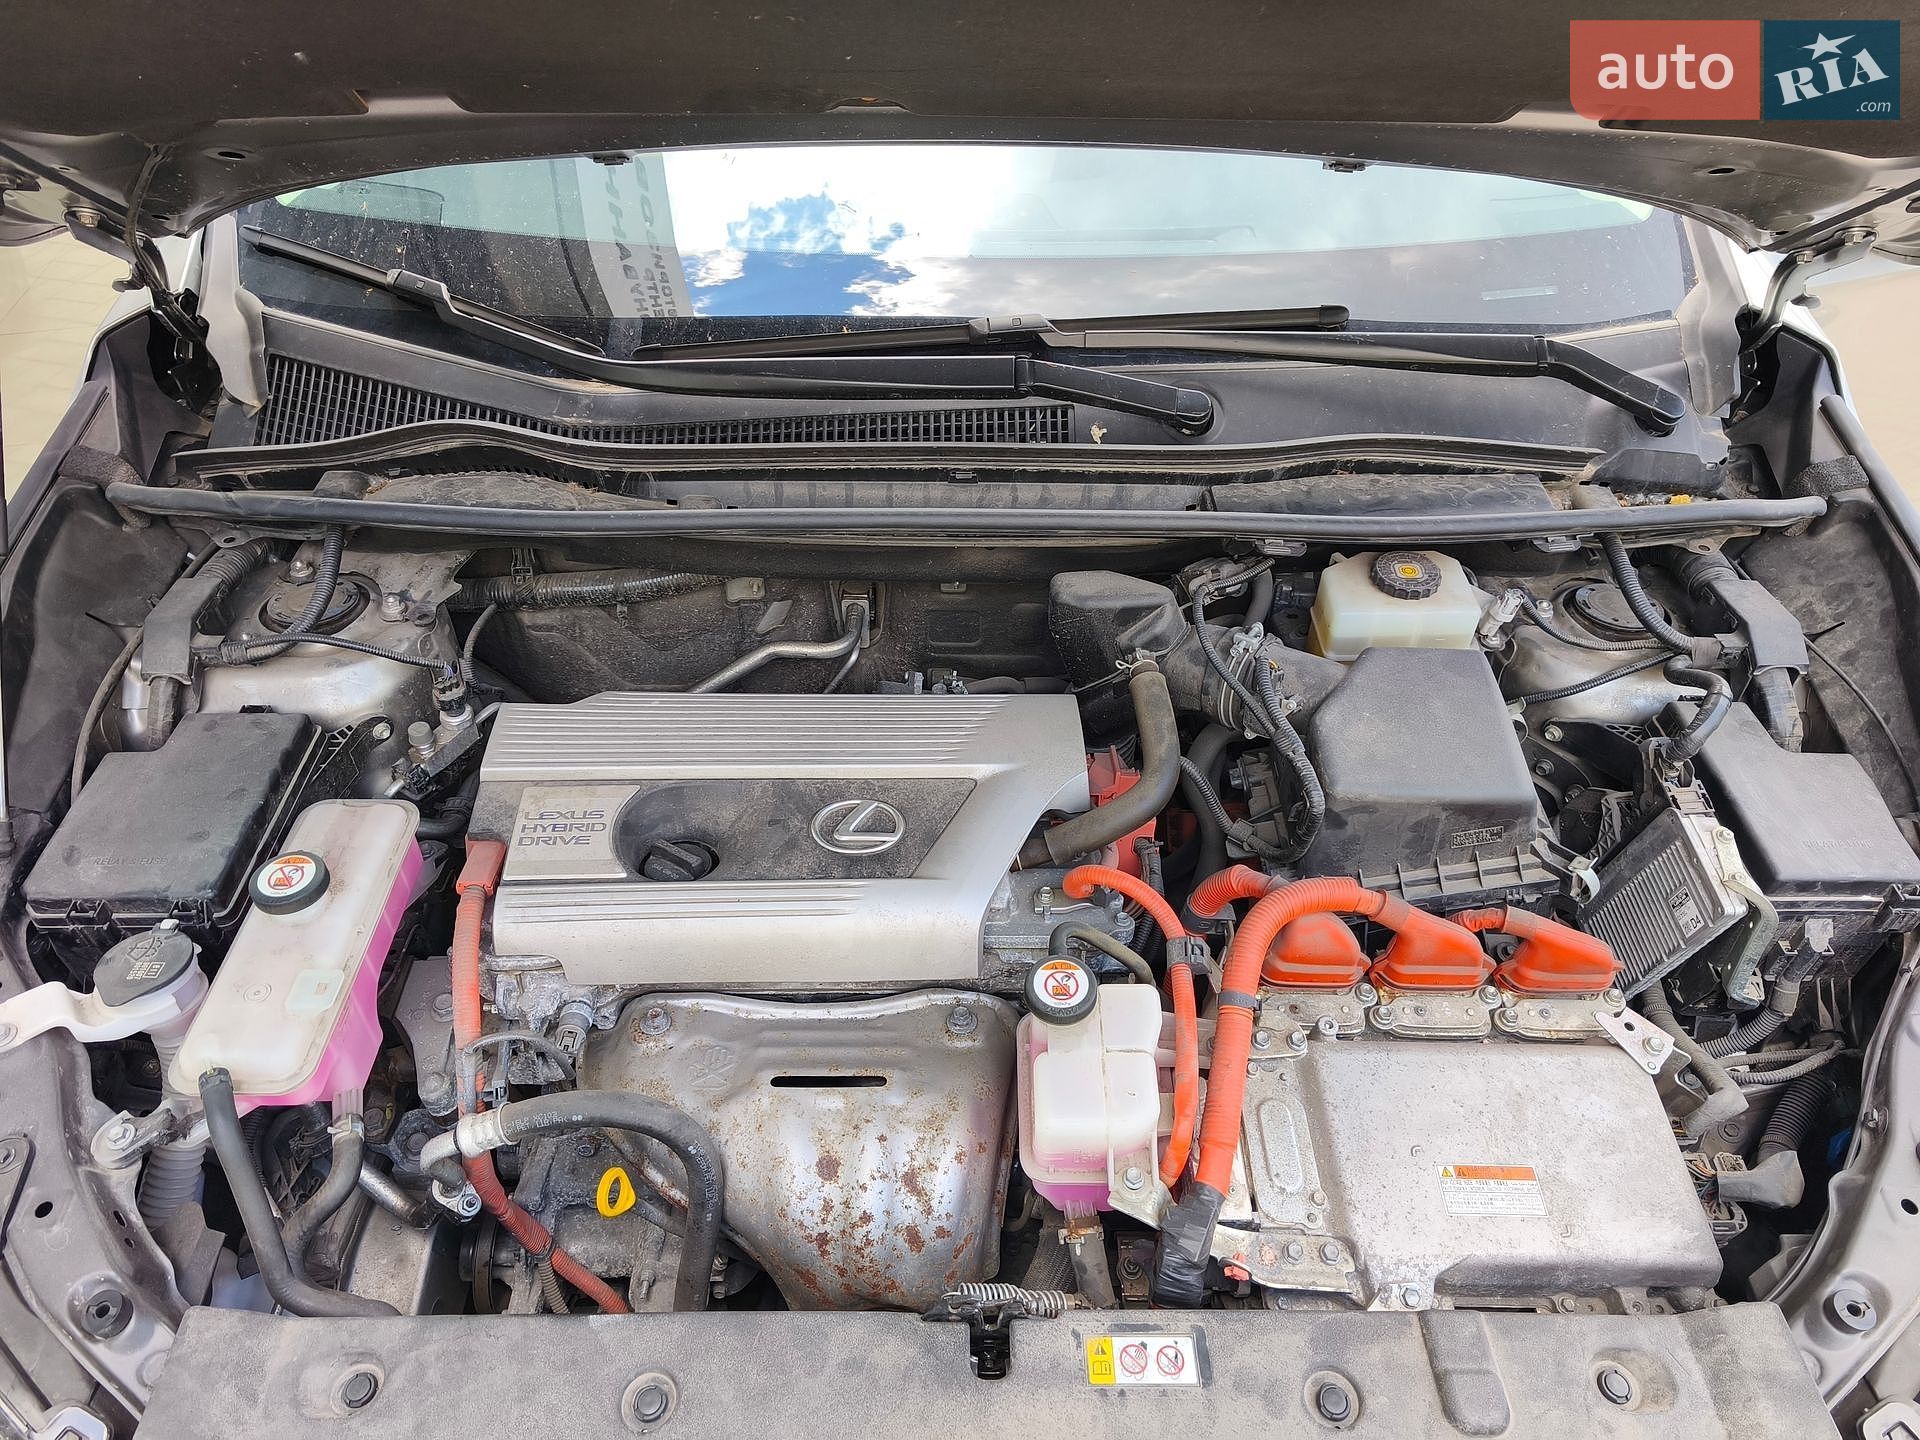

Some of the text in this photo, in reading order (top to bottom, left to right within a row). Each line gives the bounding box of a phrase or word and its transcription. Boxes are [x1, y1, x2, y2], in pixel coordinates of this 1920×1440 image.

[523, 809, 605, 821] LEXUS
[520, 822, 607, 833] HYBRID
[517, 835, 592, 846] DRIVE
